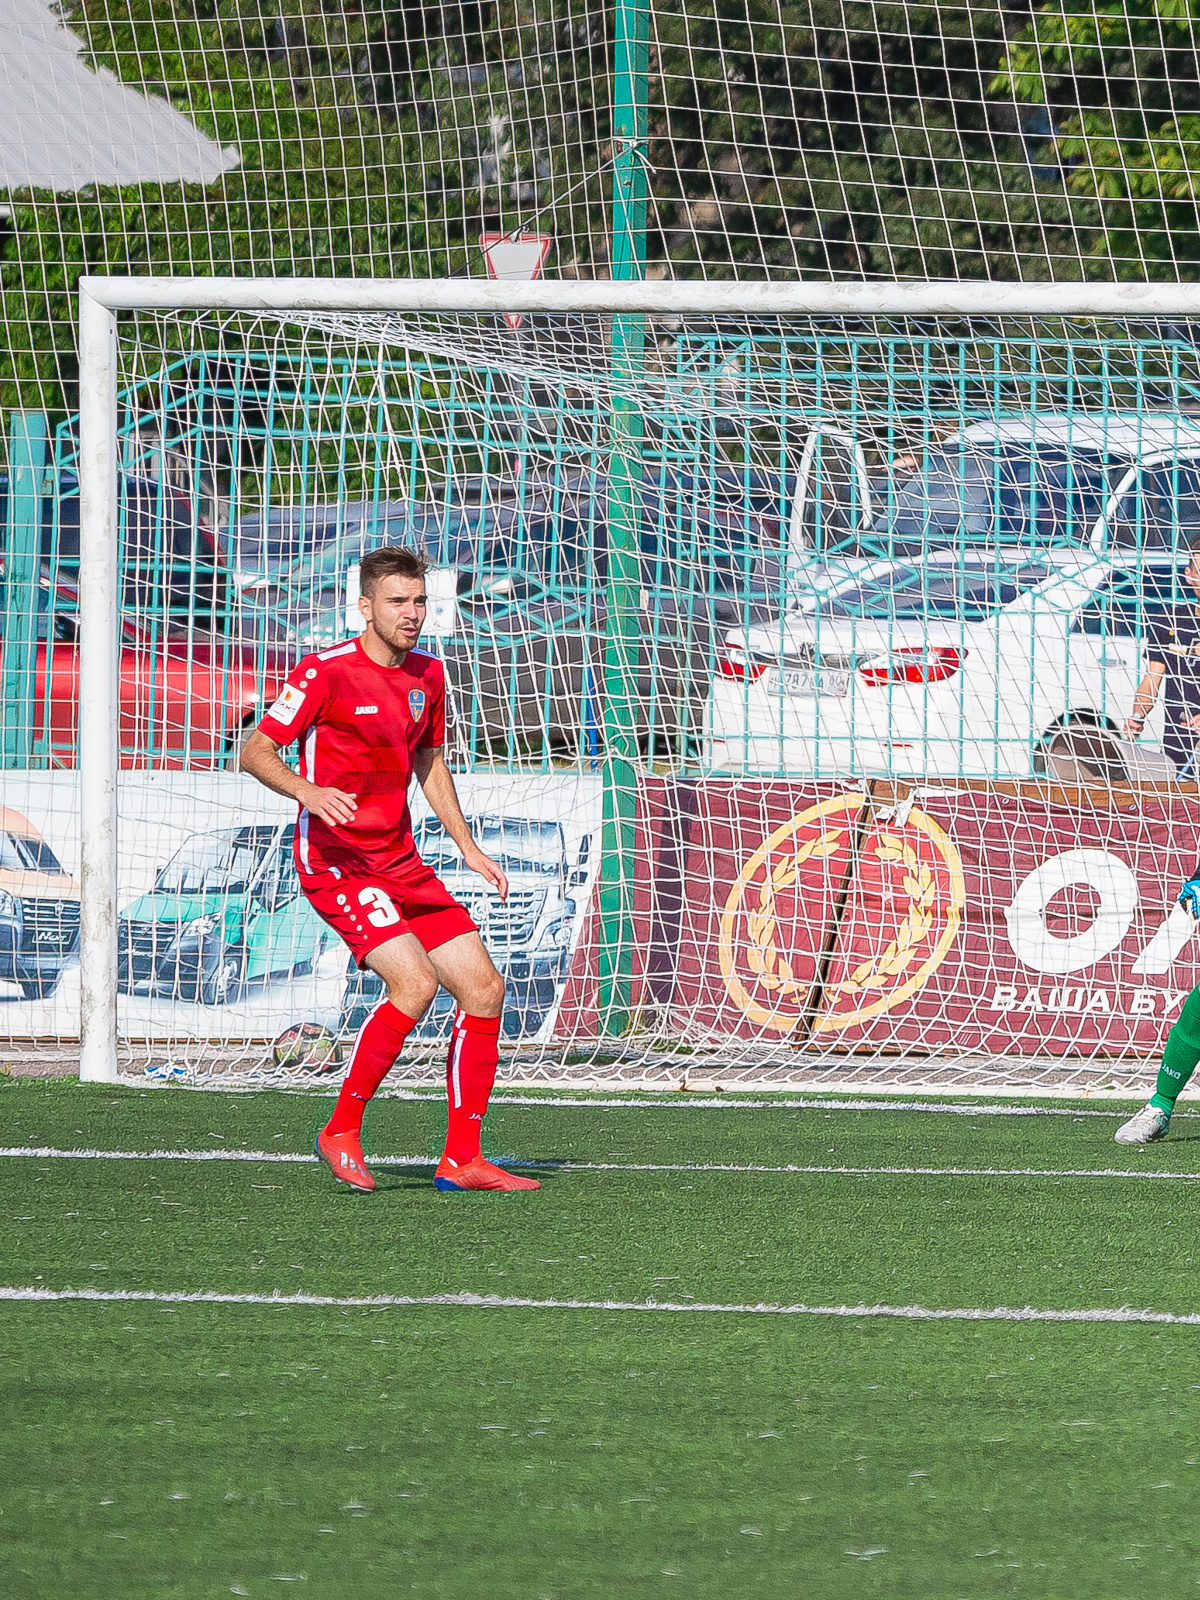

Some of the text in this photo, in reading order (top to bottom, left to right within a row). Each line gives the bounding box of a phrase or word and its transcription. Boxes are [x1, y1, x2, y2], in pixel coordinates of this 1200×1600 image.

[357, 885, 401, 928] 3
[989, 985, 1112, 1013] ВАША
[1162, 1063, 1181, 1080] JAKO
